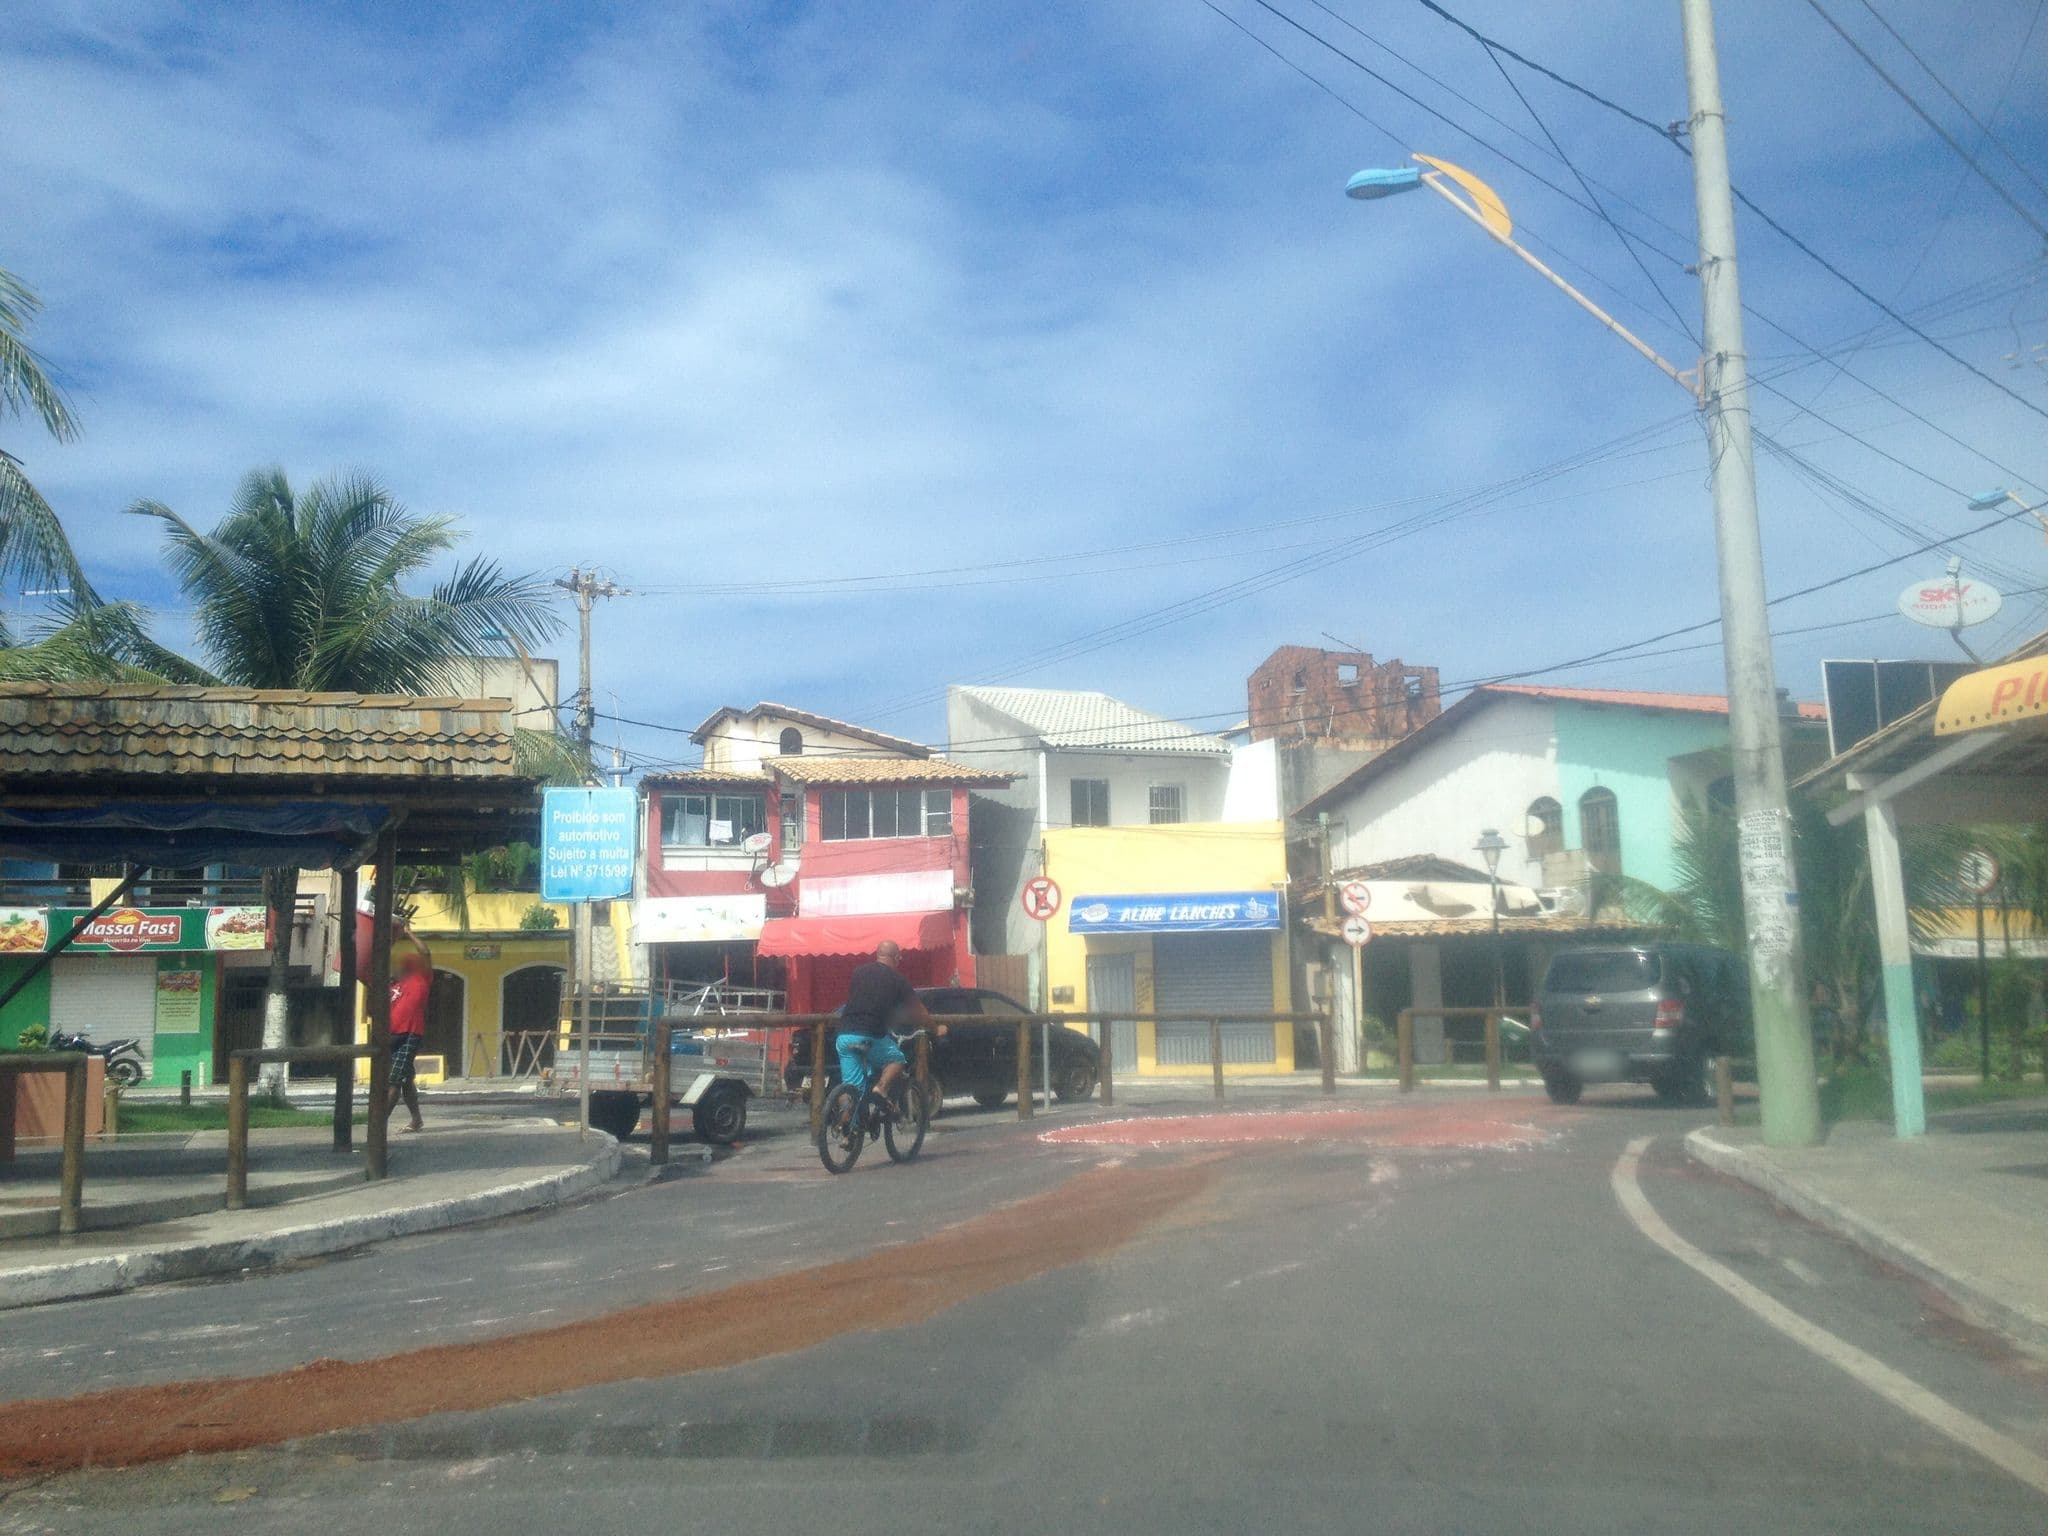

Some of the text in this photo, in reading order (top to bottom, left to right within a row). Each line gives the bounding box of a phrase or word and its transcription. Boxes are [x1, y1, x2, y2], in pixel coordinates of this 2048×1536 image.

[553, 811, 626, 823] Proibido som
[558, 830, 620, 842] automotivo
[548, 847, 629, 863] Sujeito a multa
[550, 864, 567, 878] Lei
[585, 863, 627, 878] 5715/98
[1119, 903, 1239, 922] ALINE LANCHES
[138, 920, 176, 935] Fast
